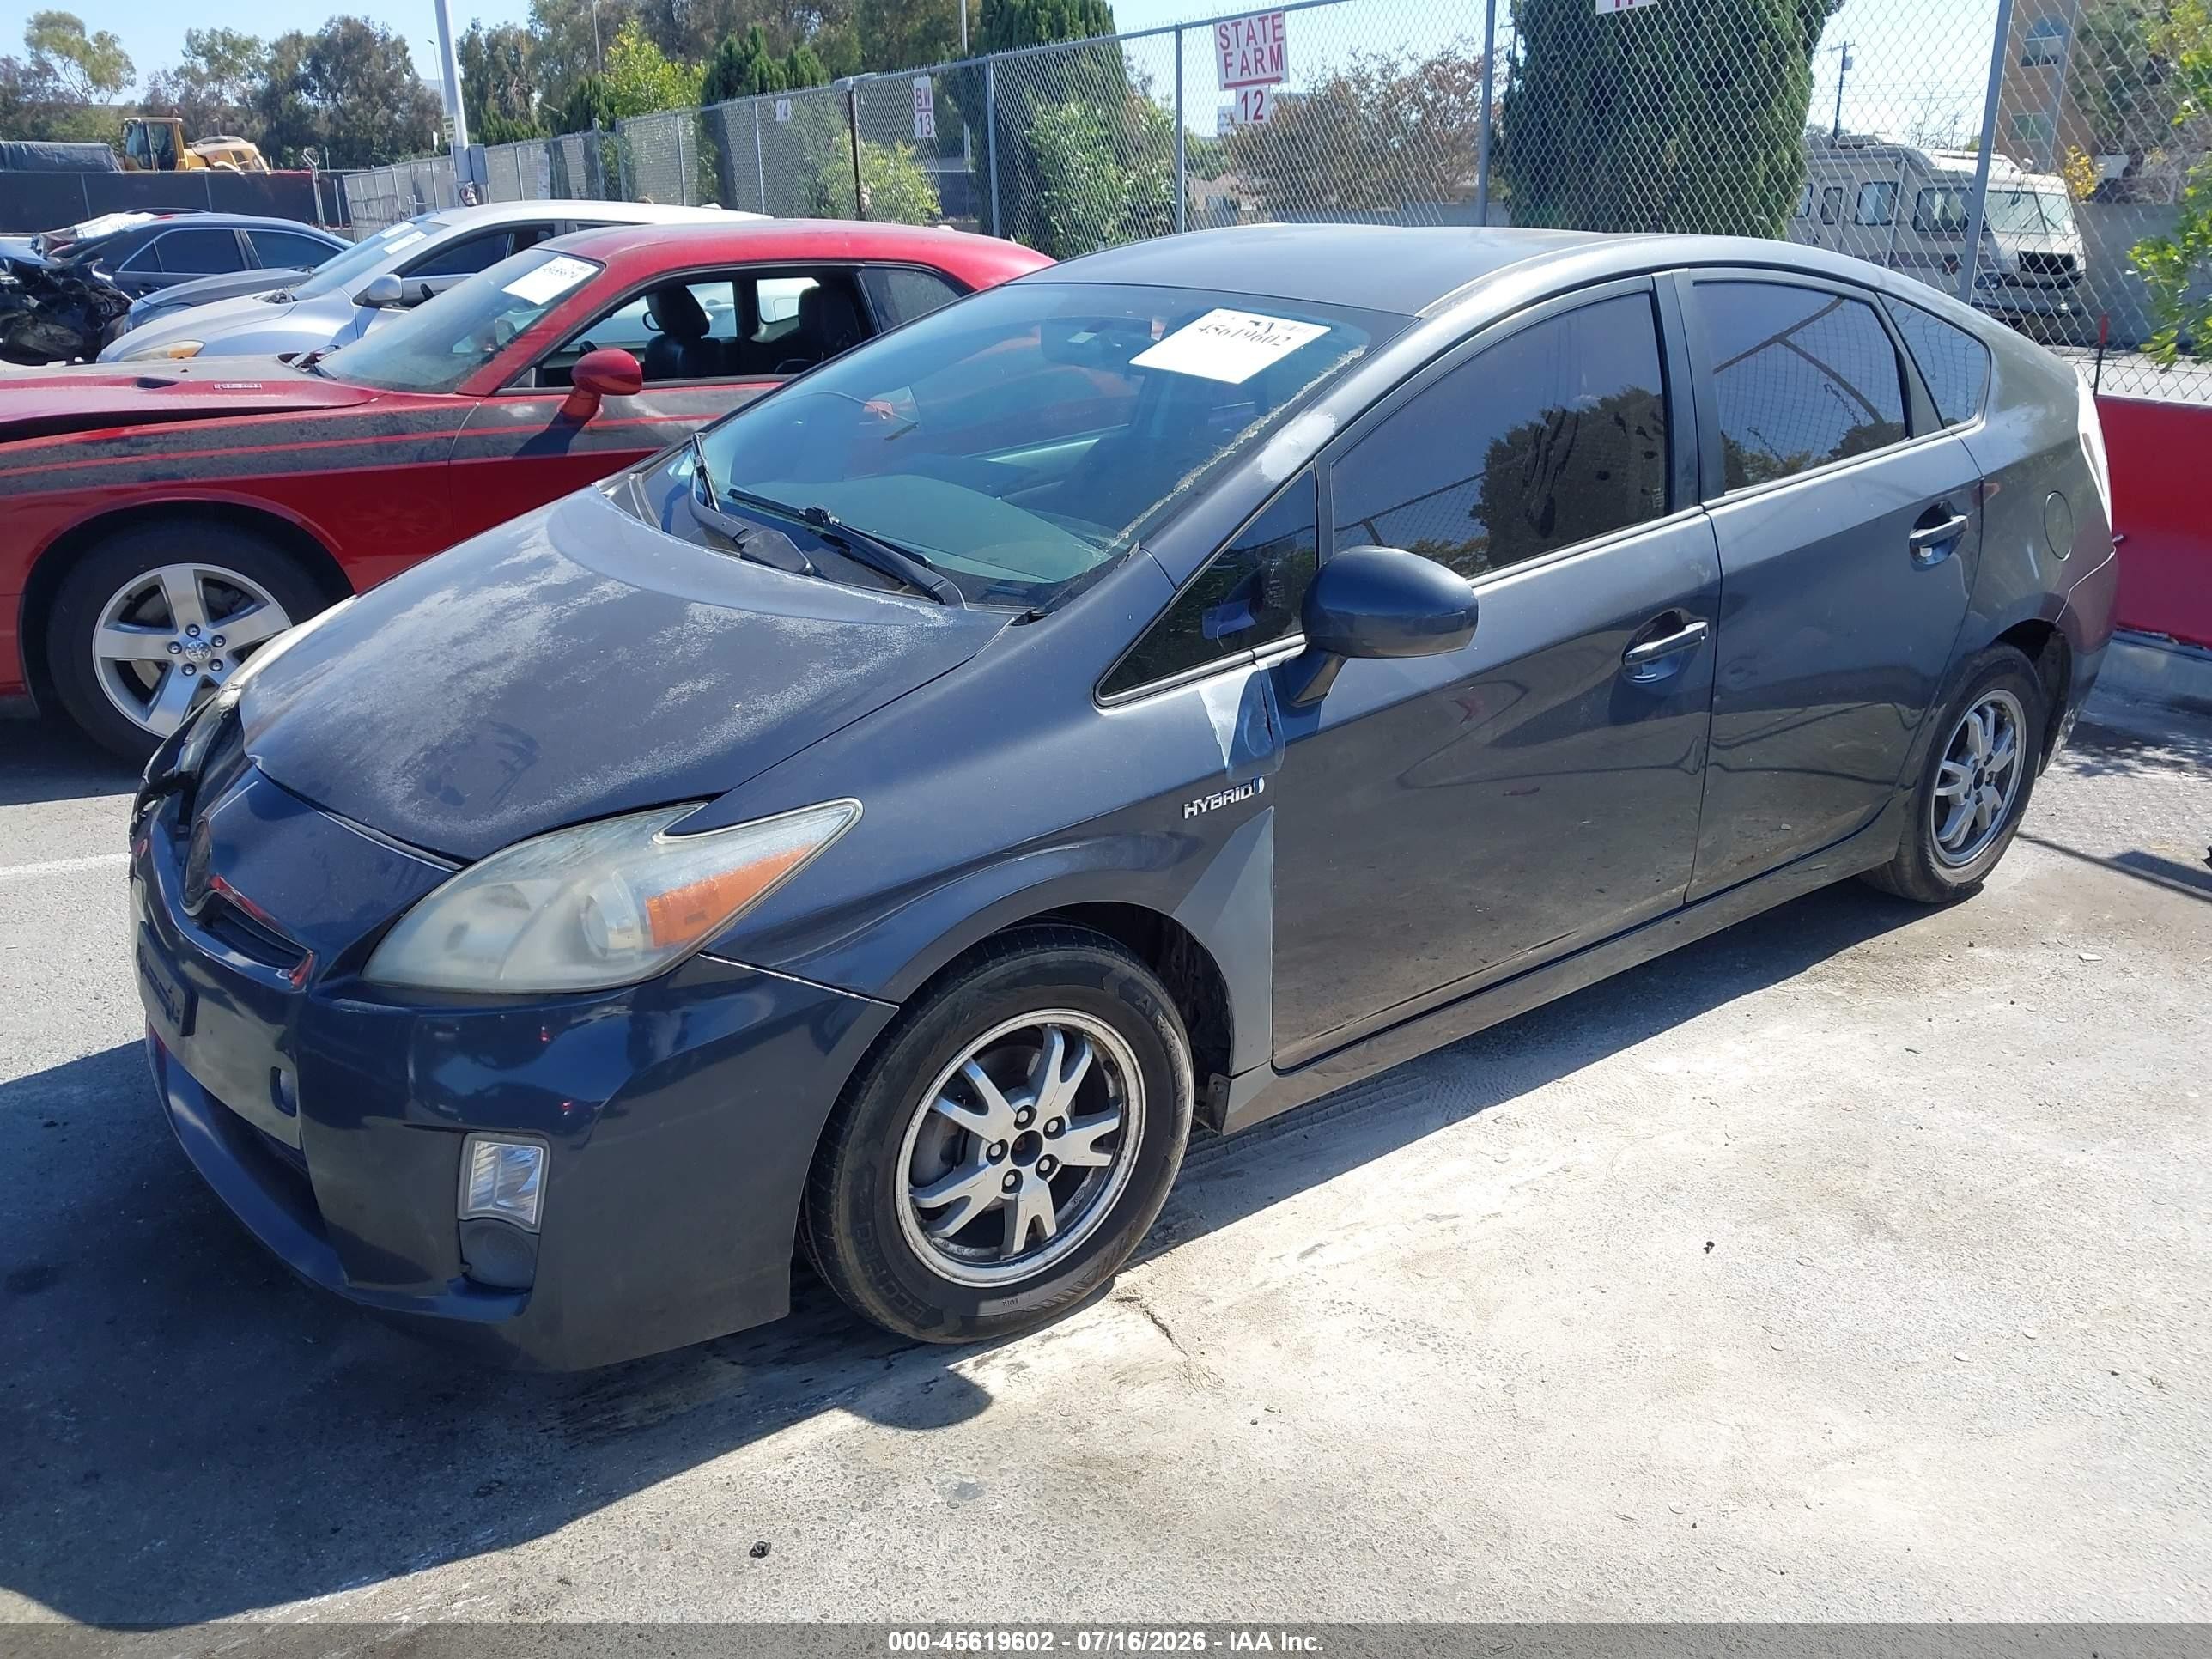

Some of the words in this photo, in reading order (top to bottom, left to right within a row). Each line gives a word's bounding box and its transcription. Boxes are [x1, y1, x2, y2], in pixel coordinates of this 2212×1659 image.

[1219, 13, 1284, 50] STATE
[1224, 44, 1283, 79] FARM
[1241, 89, 1264, 121] 12
[919, 112, 932, 136] 13
[1183, 783, 1255, 820] HYBRID
